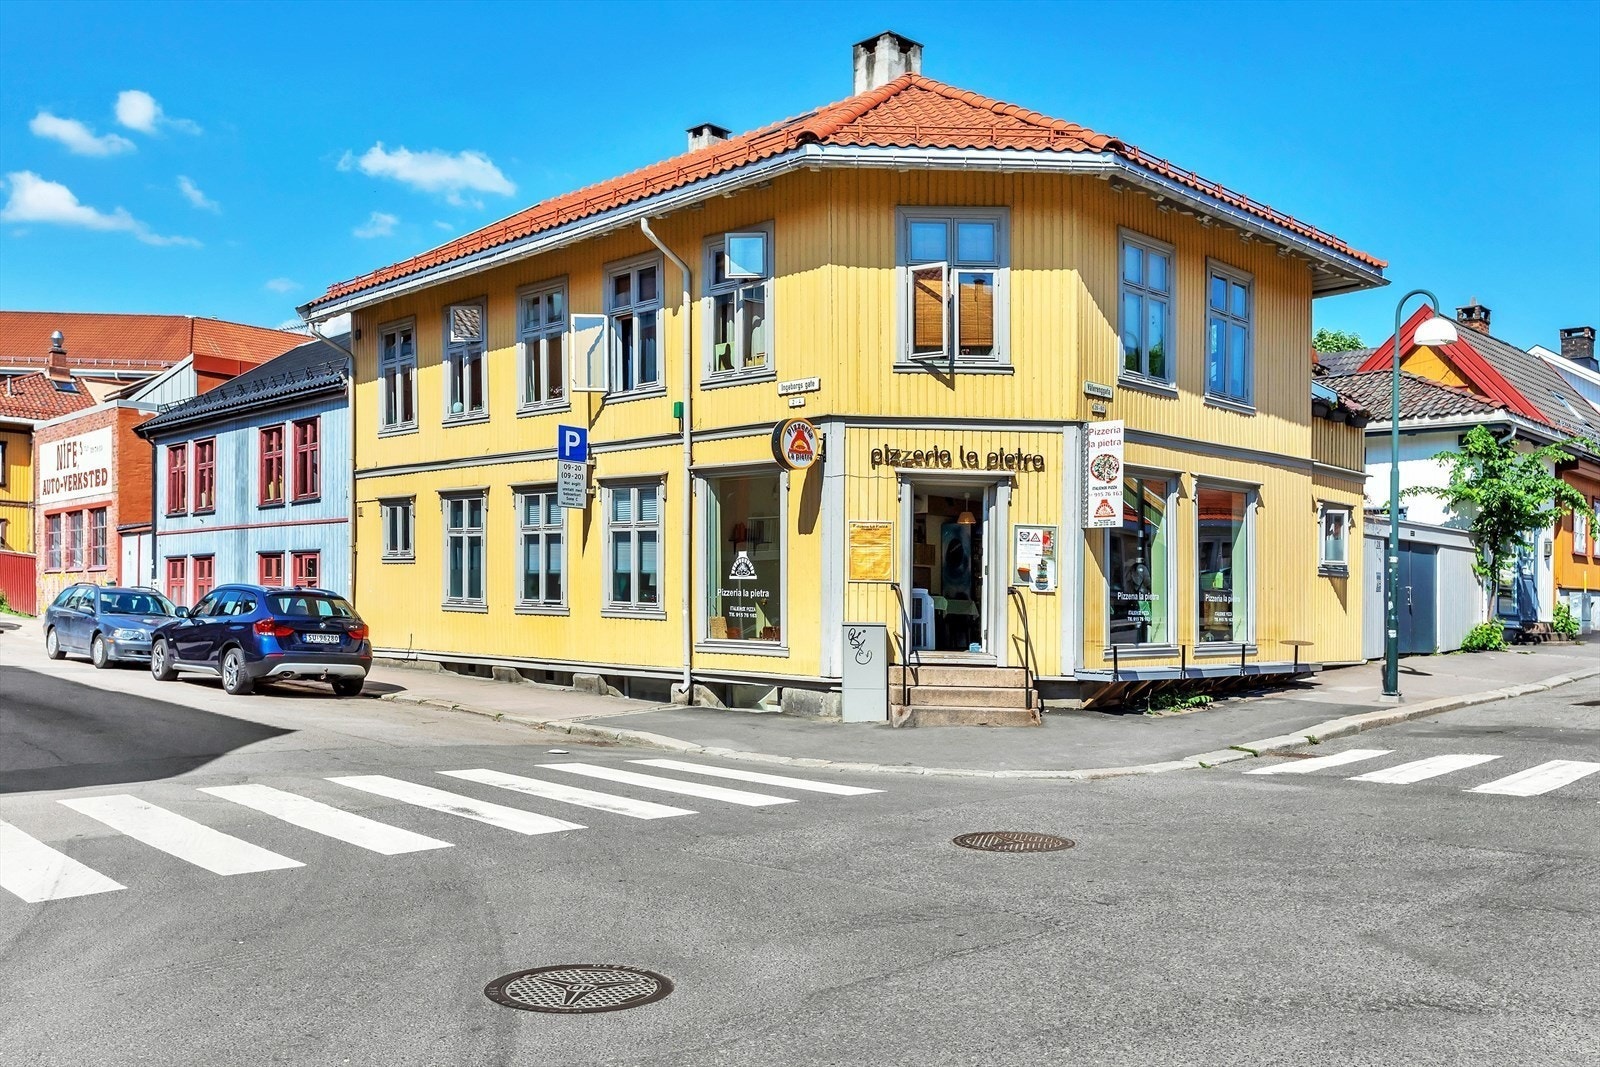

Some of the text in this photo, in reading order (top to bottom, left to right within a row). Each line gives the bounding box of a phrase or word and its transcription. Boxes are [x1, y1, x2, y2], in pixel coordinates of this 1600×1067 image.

[781, 380, 815, 392] Ingeborgs gate
[1088, 427, 1121, 436] Pizzeria
[565, 430, 581, 457] P
[1097, 439, 1122, 449] pietra
[870, 443, 1046, 472] pizzeria la pietra
[563, 463, 582, 472] 09-20
[561, 471, 584, 481] (09-20)
[42, 467, 108, 496] AUTO-VERKSTED
[717, 588, 770, 599] Pizzeria la pietra
[1138, 591, 1144, 600] la
[1205, 593, 1223, 603] Pizzeria
[1222, 594, 1228, 602] la
